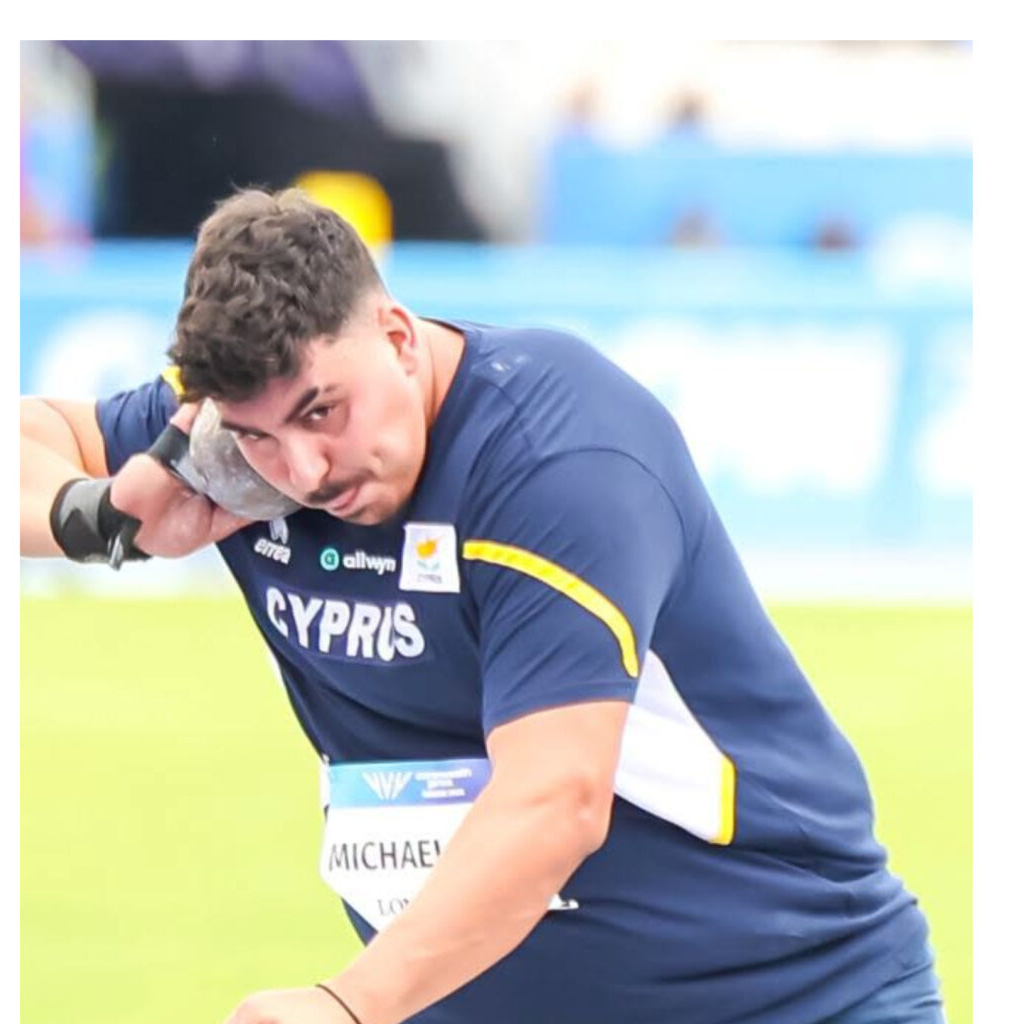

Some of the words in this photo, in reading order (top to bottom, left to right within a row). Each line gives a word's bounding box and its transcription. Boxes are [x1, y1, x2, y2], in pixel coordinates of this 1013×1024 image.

[343, 550, 396, 575] allwyn
[266, 586, 425, 662] CYPRUS
[377, 897, 409, 916] LO
